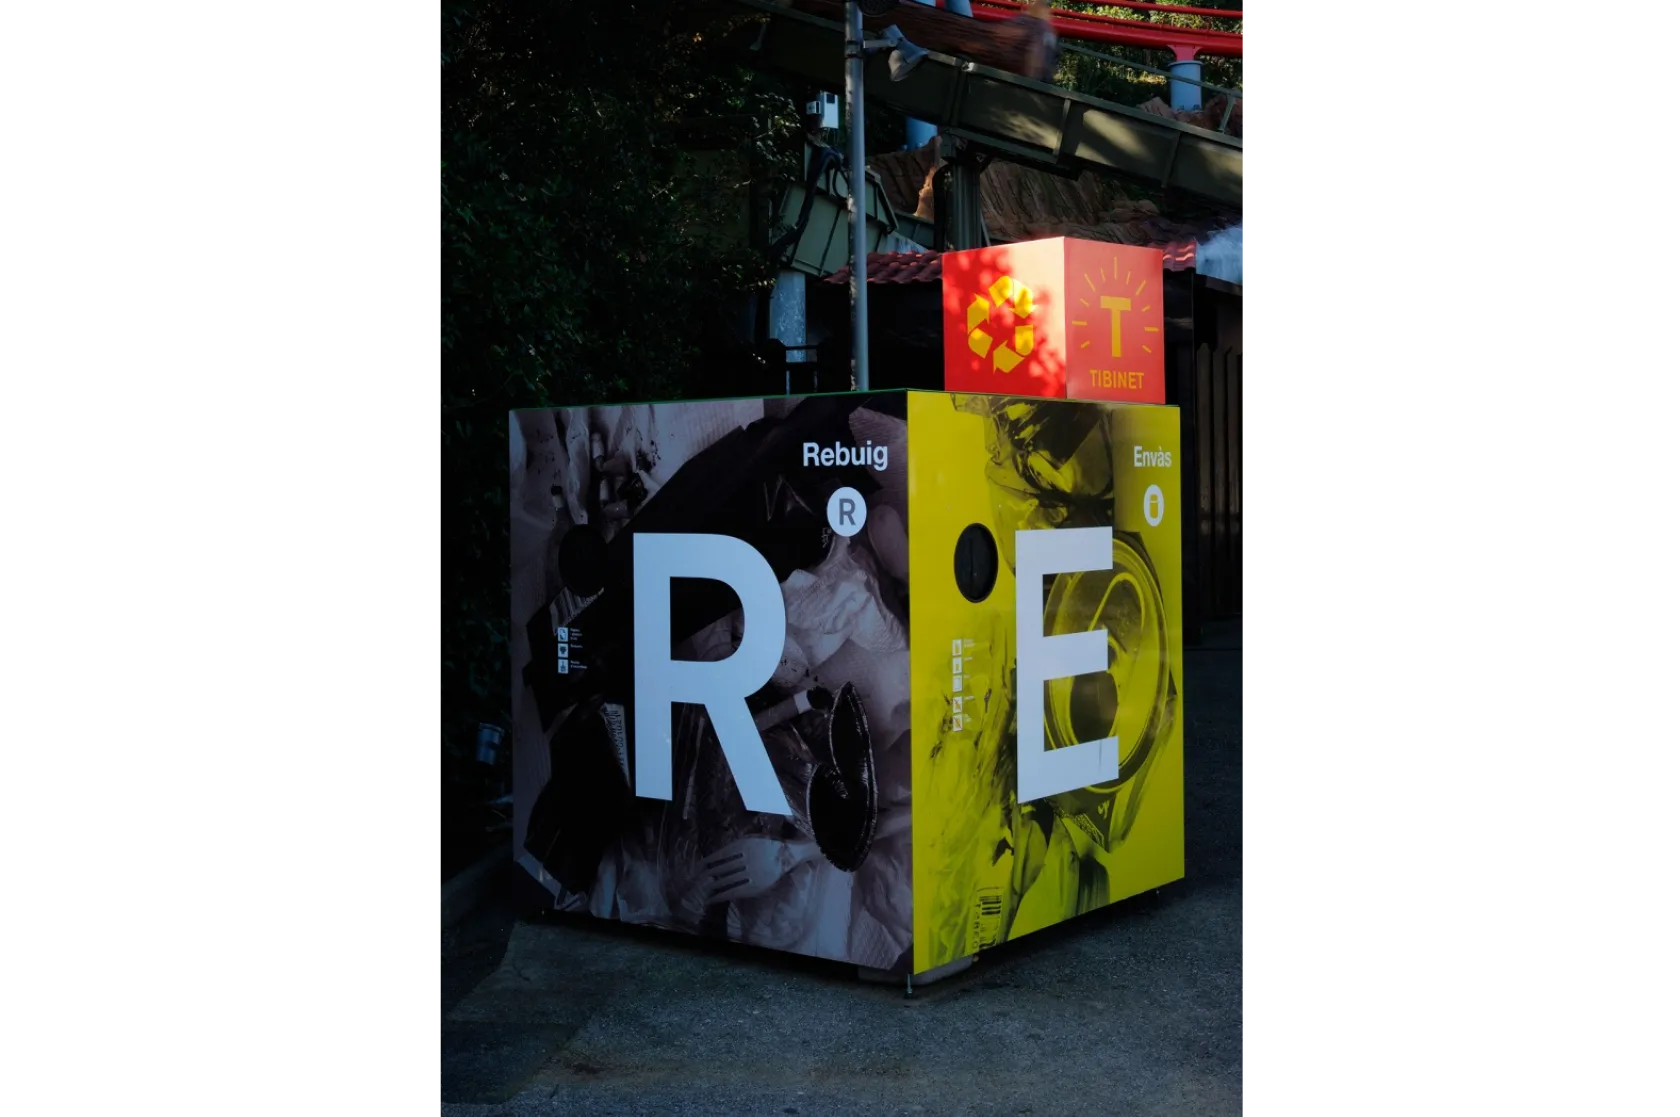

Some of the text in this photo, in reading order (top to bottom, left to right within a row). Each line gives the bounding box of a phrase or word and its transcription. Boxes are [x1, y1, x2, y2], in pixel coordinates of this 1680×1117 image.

[1100, 296, 1131, 357] T
[1089, 368, 1145, 389] TIBINET
[803, 440, 888, 471] Rebuig
[1134, 445, 1172, 468] Envàs
[838, 498, 856, 526] R
[633, 532, 793, 817] R
[1015, 527, 1119, 804] E
